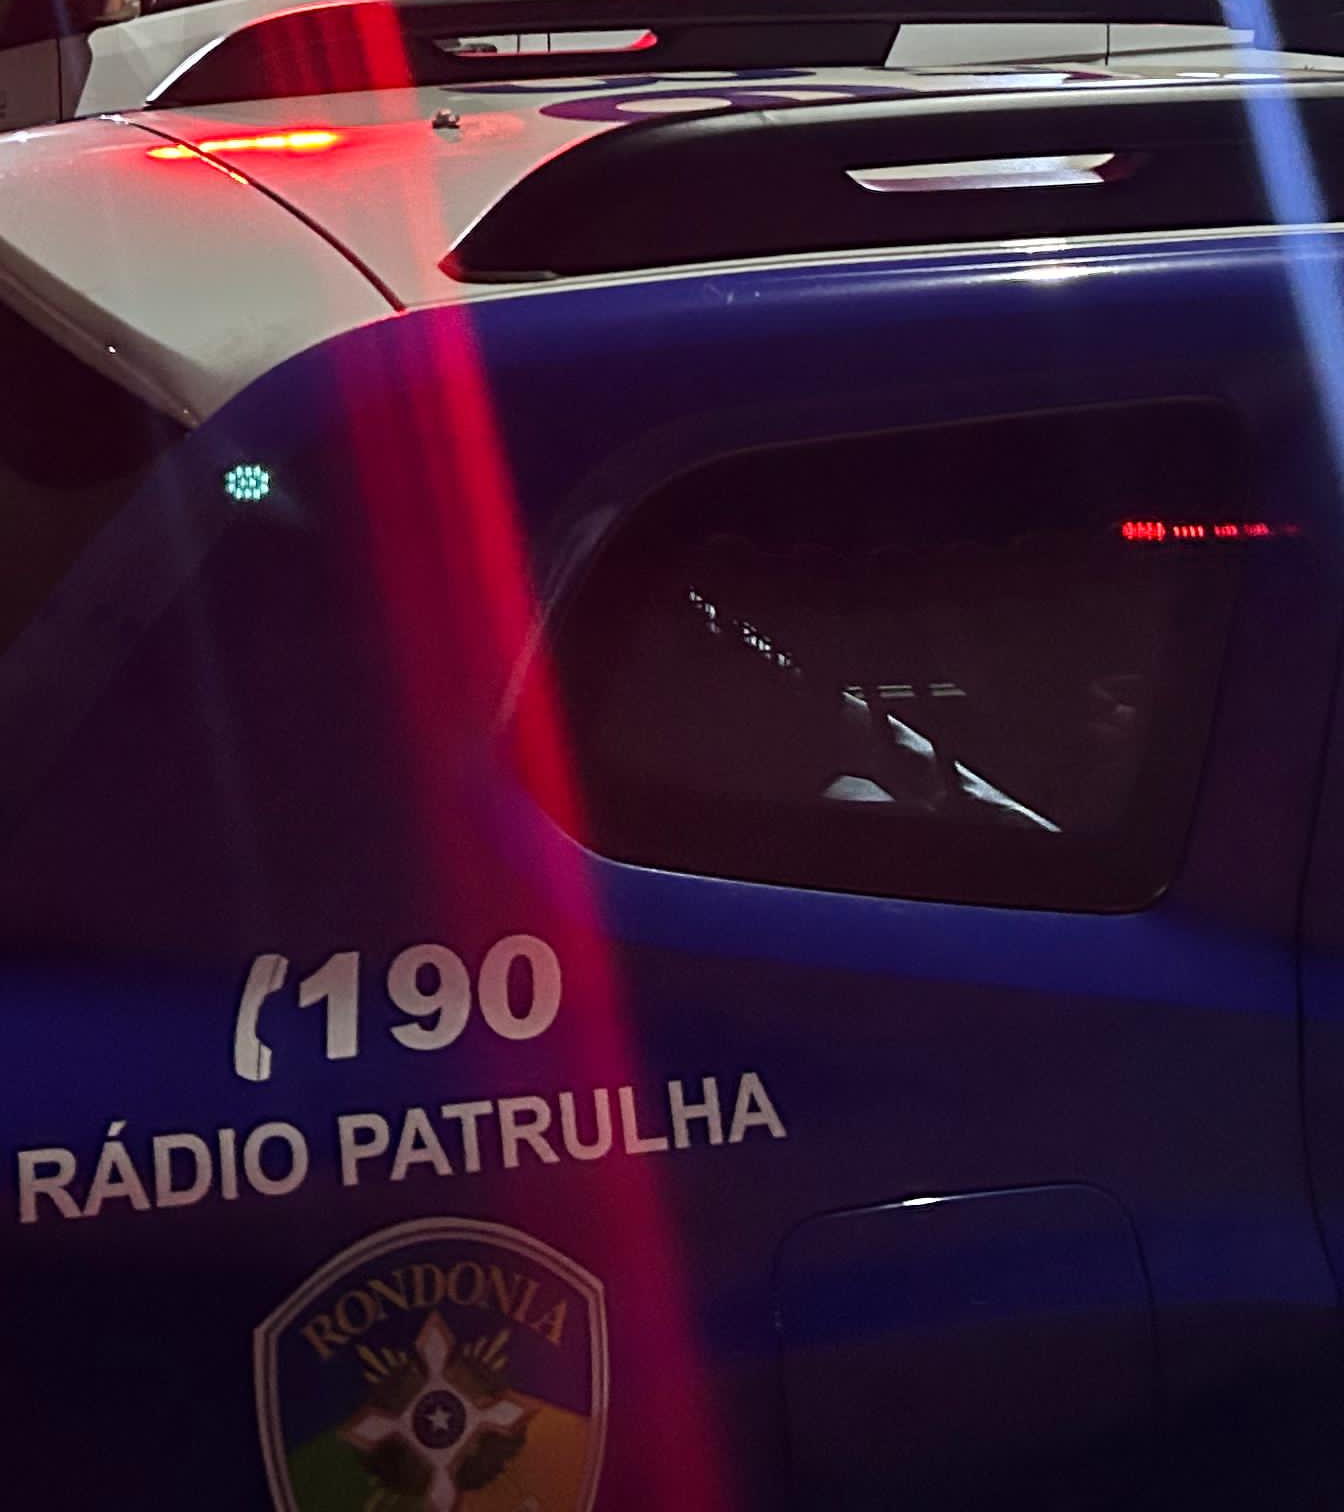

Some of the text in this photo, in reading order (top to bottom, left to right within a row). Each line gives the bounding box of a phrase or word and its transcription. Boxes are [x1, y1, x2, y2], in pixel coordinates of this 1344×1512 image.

[298, 934, 563, 1060] 190
[17, 1071, 789, 1224] RÁDIO PATRULHA
